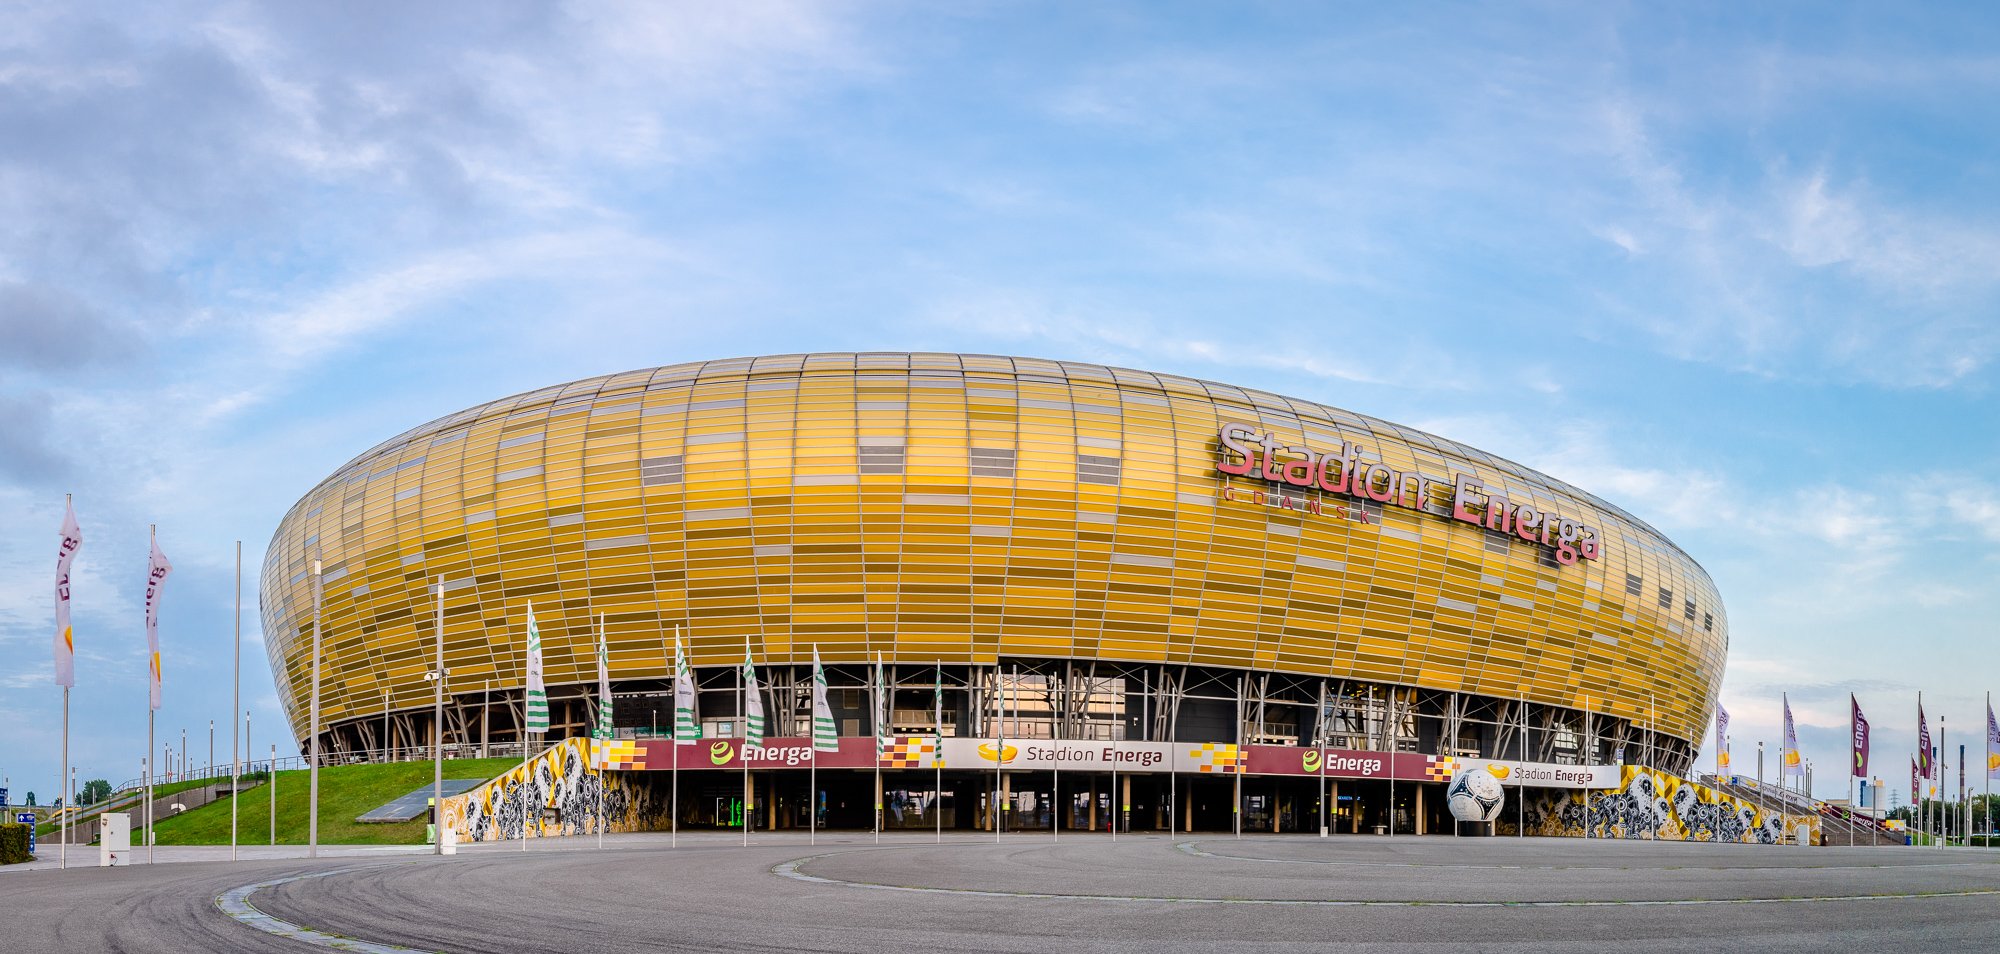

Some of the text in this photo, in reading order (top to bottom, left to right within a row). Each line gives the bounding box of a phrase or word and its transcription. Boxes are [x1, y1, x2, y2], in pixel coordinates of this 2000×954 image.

[1217, 421, 1600, 566] Stadion Energa
[740, 744, 813, 766] Energa
[1027, 746, 1162, 767] Stadion Energa
[1326, 754, 1382, 776] Energa
[1514, 767, 1593, 785] Stadion Energa
